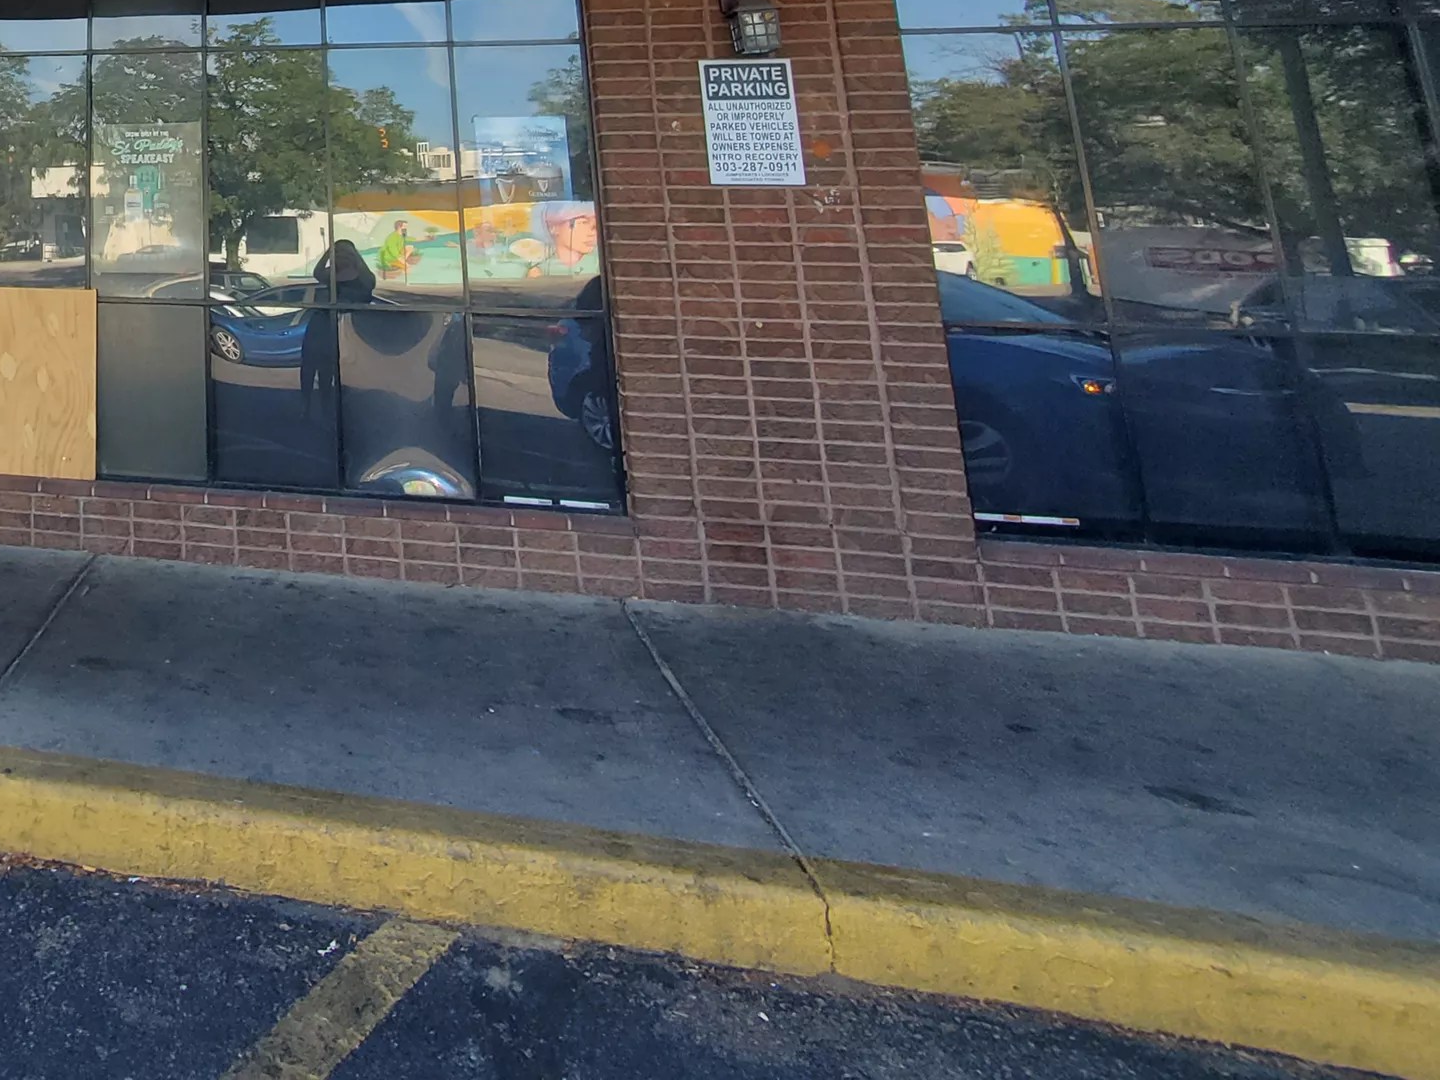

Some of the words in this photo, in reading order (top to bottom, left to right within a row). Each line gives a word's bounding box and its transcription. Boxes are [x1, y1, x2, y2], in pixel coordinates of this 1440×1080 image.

[709, 67, 783, 81] PRIVATE
[708, 82, 787, 96] PARKING
[708, 102, 725, 111] ALL
[726, 102, 792, 111] UNAUTHORIZED
[717, 112, 729, 120] OR
[731, 112, 785, 120] IMPROPERLY
[710, 122, 747, 131] PARKED
[749, 122, 794, 130] VEHICLES
[712, 132, 732, 141] WILL
[735, 132, 747, 140] BE
[750, 132, 781, 140] TOWED
[783, 132, 794, 140] AT
[712, 143, 751, 151] OWNERS
[753, 143, 798, 151] EXPENSE.
[120, 153, 175, 164] SPEAKEASY
[712, 153, 741, 161] NITRO
[715, 162, 797, 171] 303-287-0911
